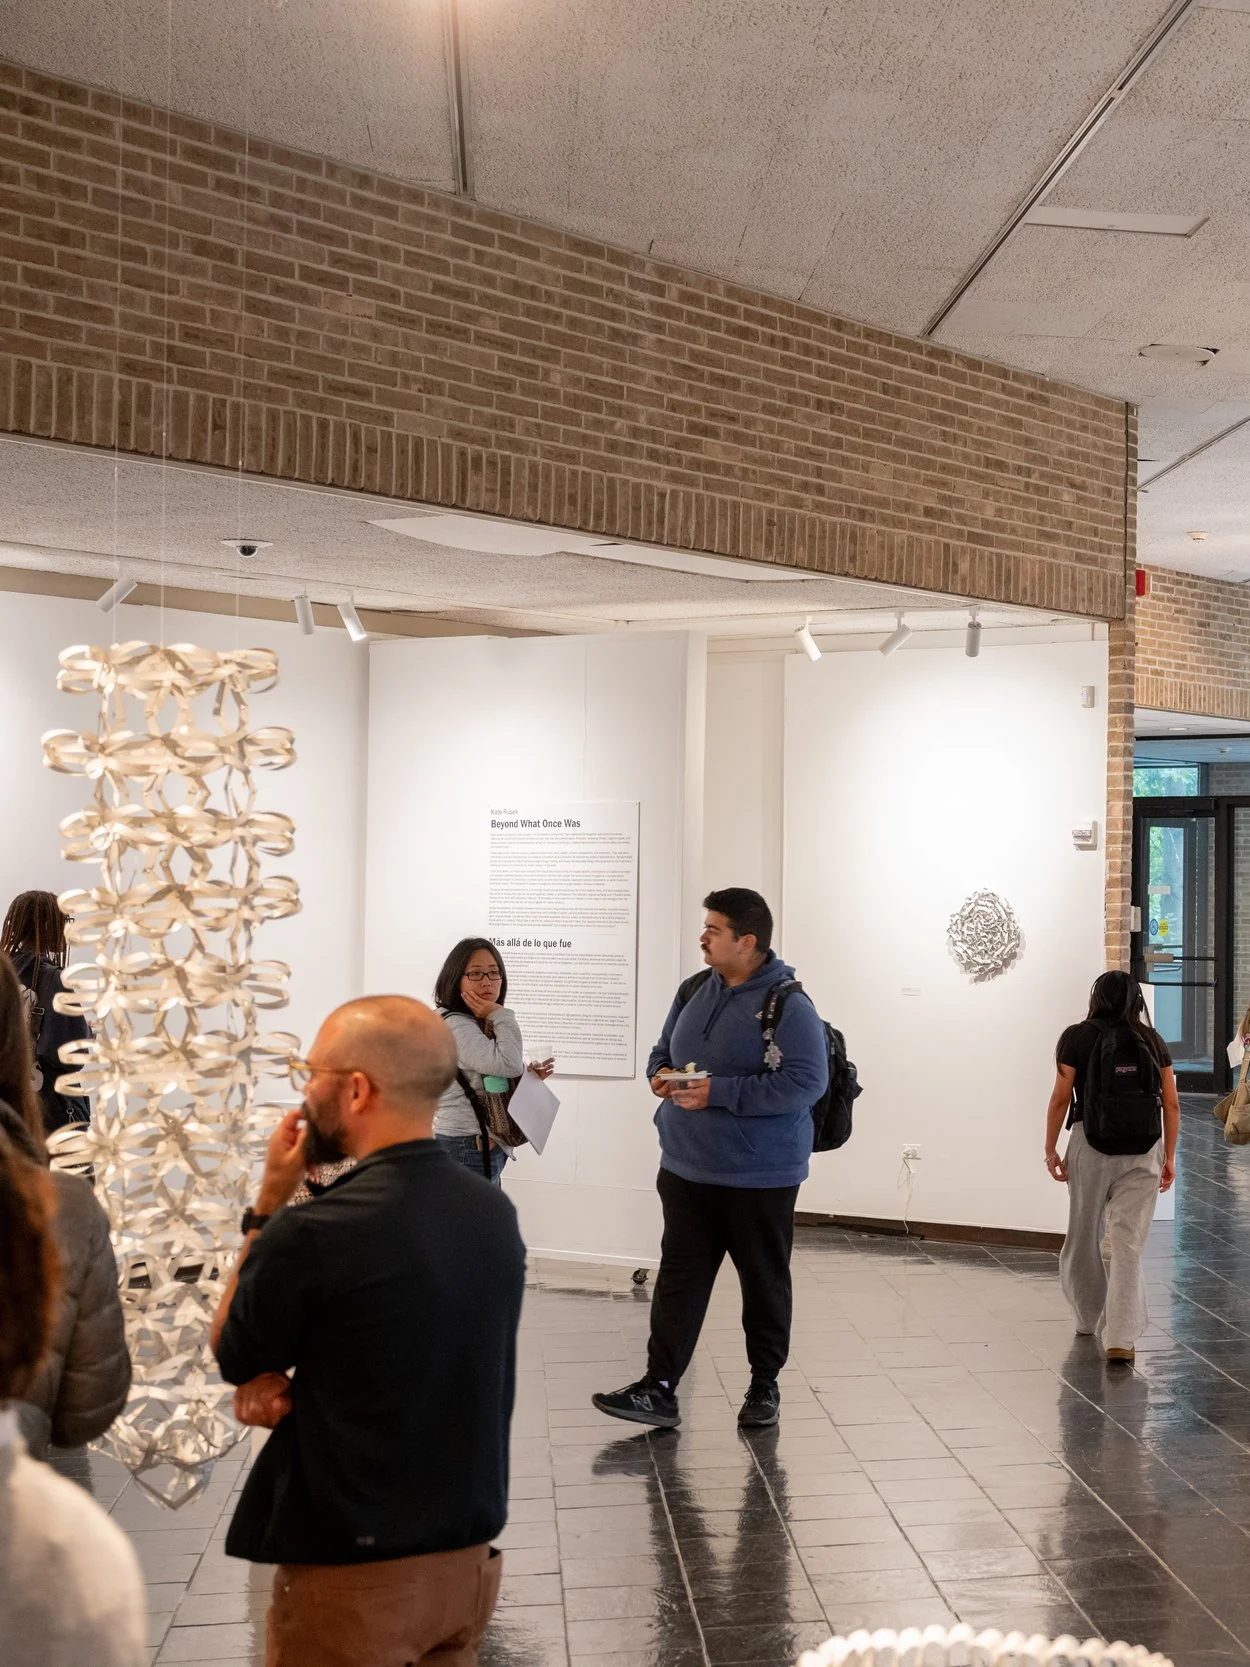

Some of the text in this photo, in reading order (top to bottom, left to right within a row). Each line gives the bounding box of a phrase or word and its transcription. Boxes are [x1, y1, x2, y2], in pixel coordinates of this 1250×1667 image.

[491, 819, 581, 830] Beyond What Once Was
[507, 937, 520, 947] allá
[522, 938, 532, 947] de
[534, 938, 542, 948] lo
[543, 940, 558, 949] que
[559, 938, 572, 948] fue
